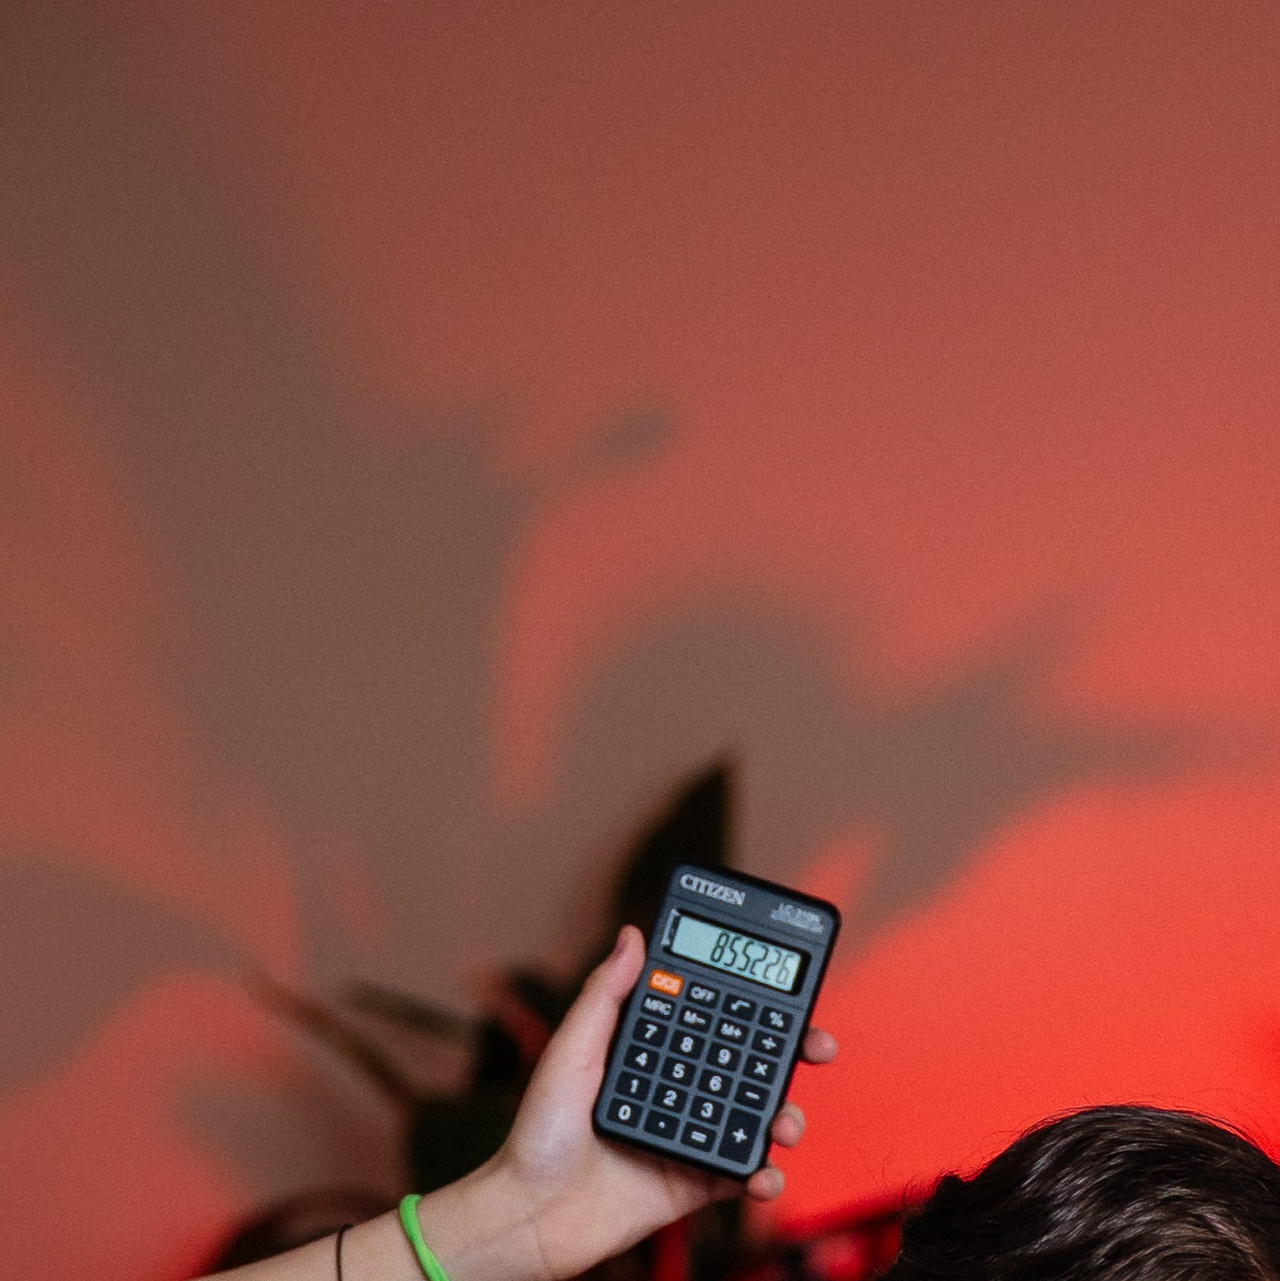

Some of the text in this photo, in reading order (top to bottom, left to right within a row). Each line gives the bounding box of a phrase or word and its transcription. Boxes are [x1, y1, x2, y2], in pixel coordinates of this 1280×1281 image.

[680, 873, 746, 907] CITIZEN
[710, 931, 793, 986] 855226
[645, 1023, 731, 1065] 7 8 9
[635, 1052, 722, 1091] 4 5 6
[618, 1105, 631, 1121] 0
[630, 1078, 714, 1118] 1 2 3
